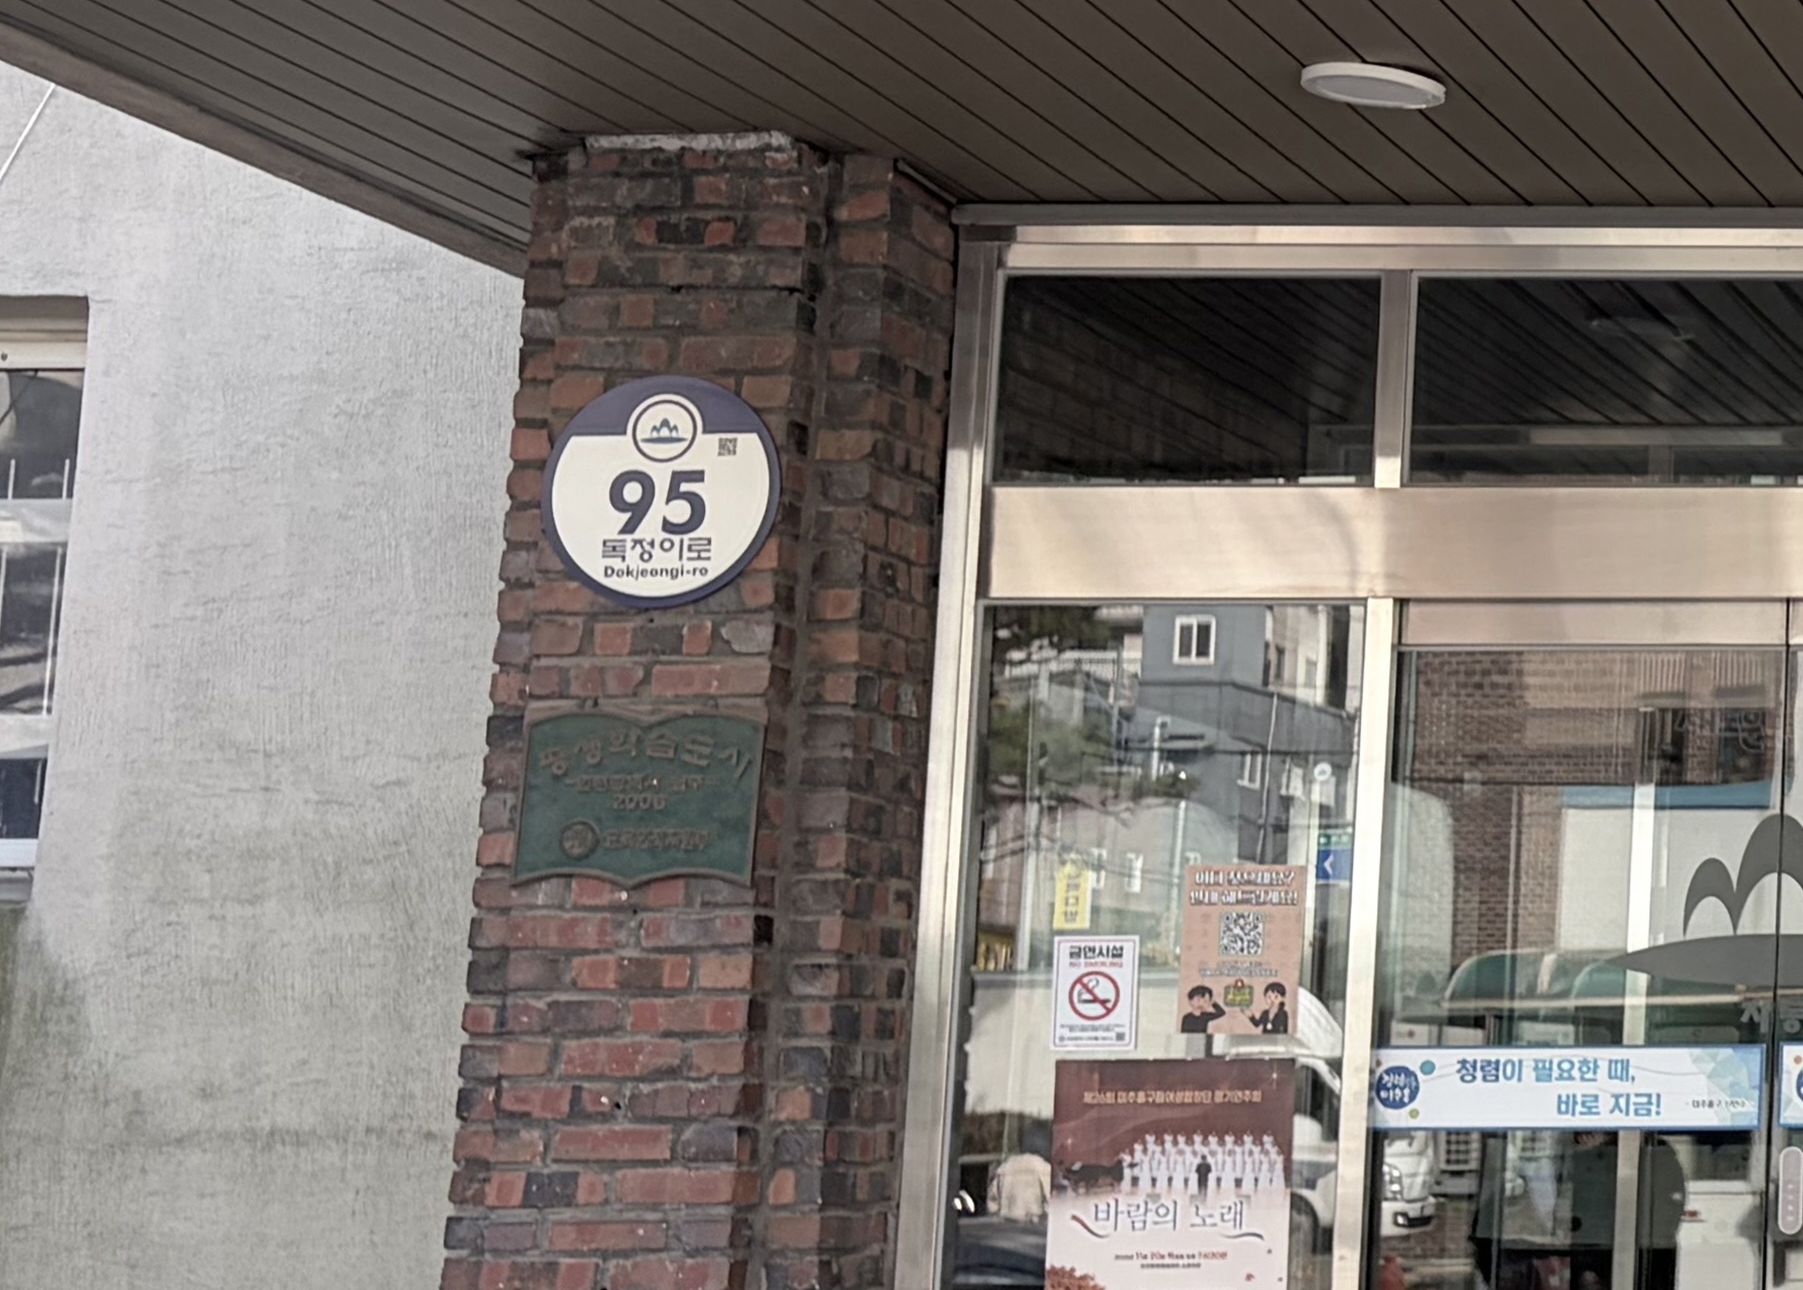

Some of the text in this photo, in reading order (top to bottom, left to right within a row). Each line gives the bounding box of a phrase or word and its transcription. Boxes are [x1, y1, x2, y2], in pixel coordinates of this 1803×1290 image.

[609, 469, 706, 535] 95
[601, 537, 712, 563] 독정이로
[603, 565, 709, 580] Dokjeongi-ro
[1456, 1058, 1636, 1084] 청렴이 필요한 때,
[1556, 1093, 1662, 1117] 바로 지금!
[1094, 1197, 1244, 1232] 바람의 노래
